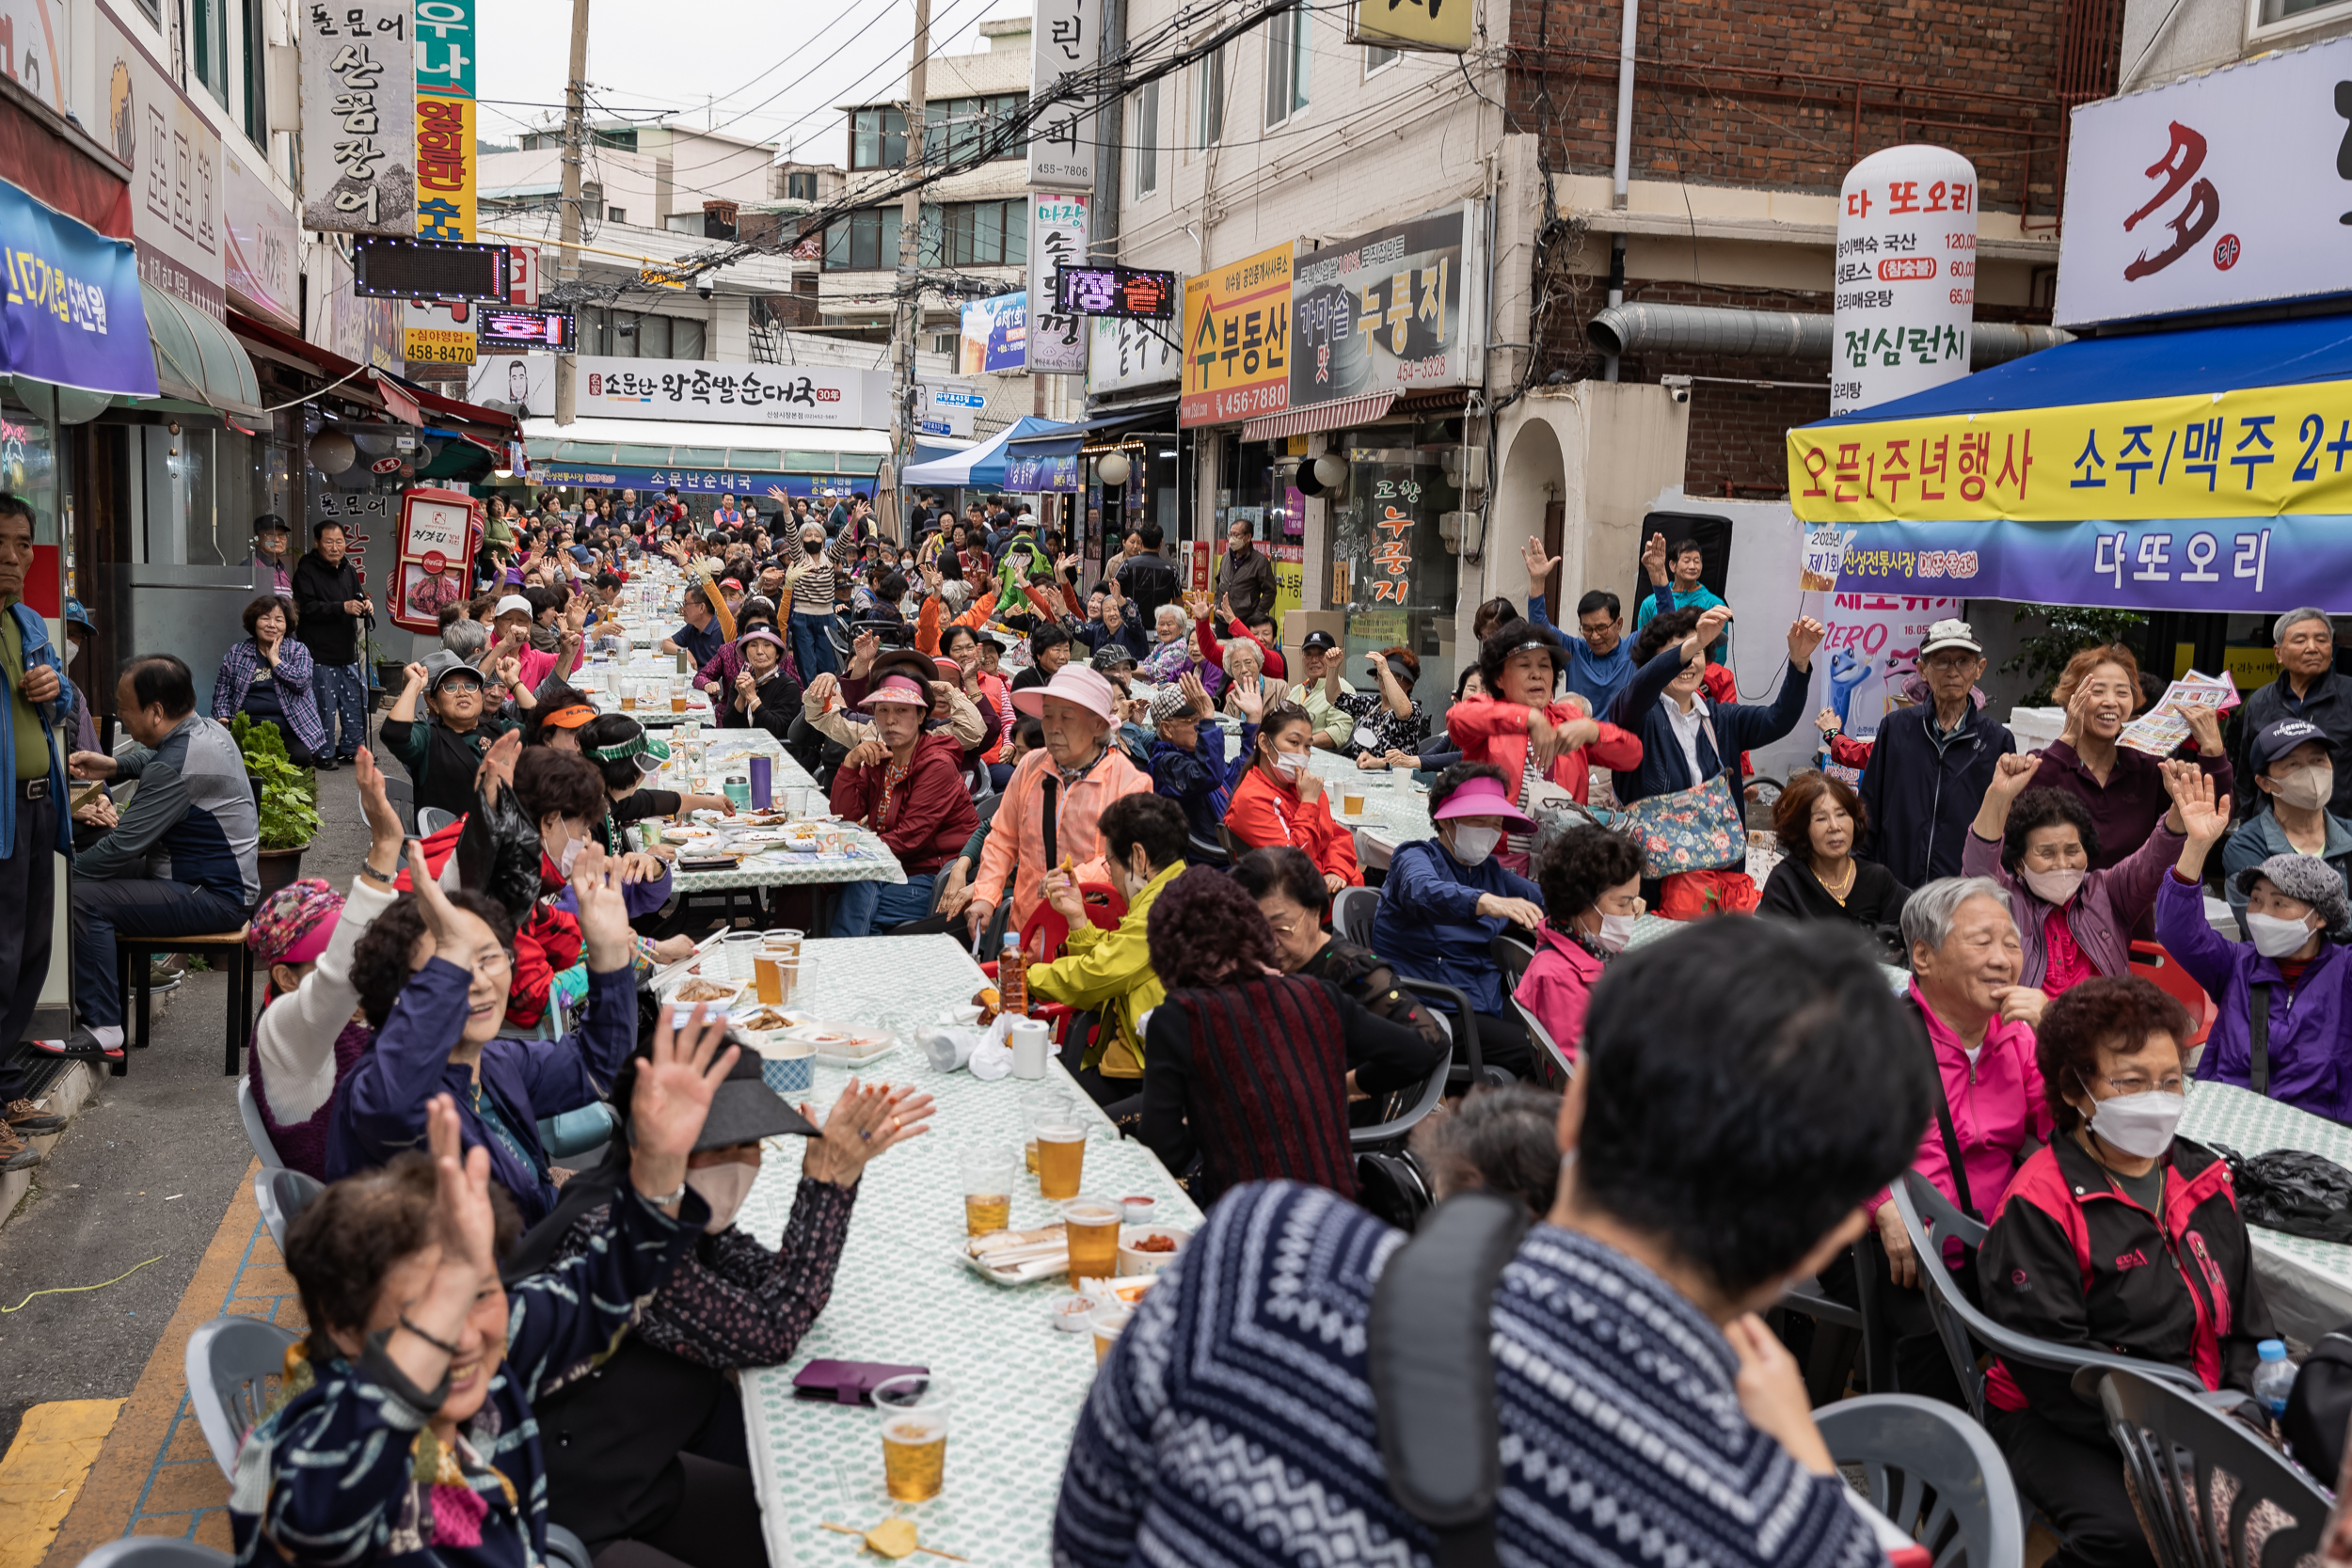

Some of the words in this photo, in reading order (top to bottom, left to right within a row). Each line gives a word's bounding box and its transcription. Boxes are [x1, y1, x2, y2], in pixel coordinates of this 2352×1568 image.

[330, 43, 384, 226] 산꼼장어
[1037, 163, 1089, 178] 455-7806
[1888, 180, 1974, 215] 또오리
[1039, 205, 1086, 228] 마장
[1883, 233, 1916, 252] 국산
[1837, 261, 1873, 285] 생로스
[1300, 287, 1349, 347] 가마솥
[1357, 256, 1448, 357] 누룽지
[1836, 290, 1894, 310] 오리매운탕
[417, 329, 463, 343] 심야영업
[1845, 324, 1964, 368] 점심런치
[407, 344, 473, 362] 458-8470
[1396, 356, 1446, 383] 454-3328
[605, 373, 658, 396] 소문난
[818, 389, 840, 402] 30年
[1225, 384, 1286, 414] 456-7880
[1833, 381, 1862, 400] 오리탕
[1801, 428, 2034, 504] 오픈1주년행사
[2070, 415, 2276, 497] 소주/맥주
[1375, 480, 1422, 502] 고향
[1812, 531, 1840, 546] 2023년
[1373, 505, 1415, 606] 누룽지
[1808, 551, 1839, 574] 제1회
[1843, 550, 1916, 578] 신성전통시장
[2094, 531, 2269, 593] 다또오리
[1823, 620, 1888, 655] ZERO
